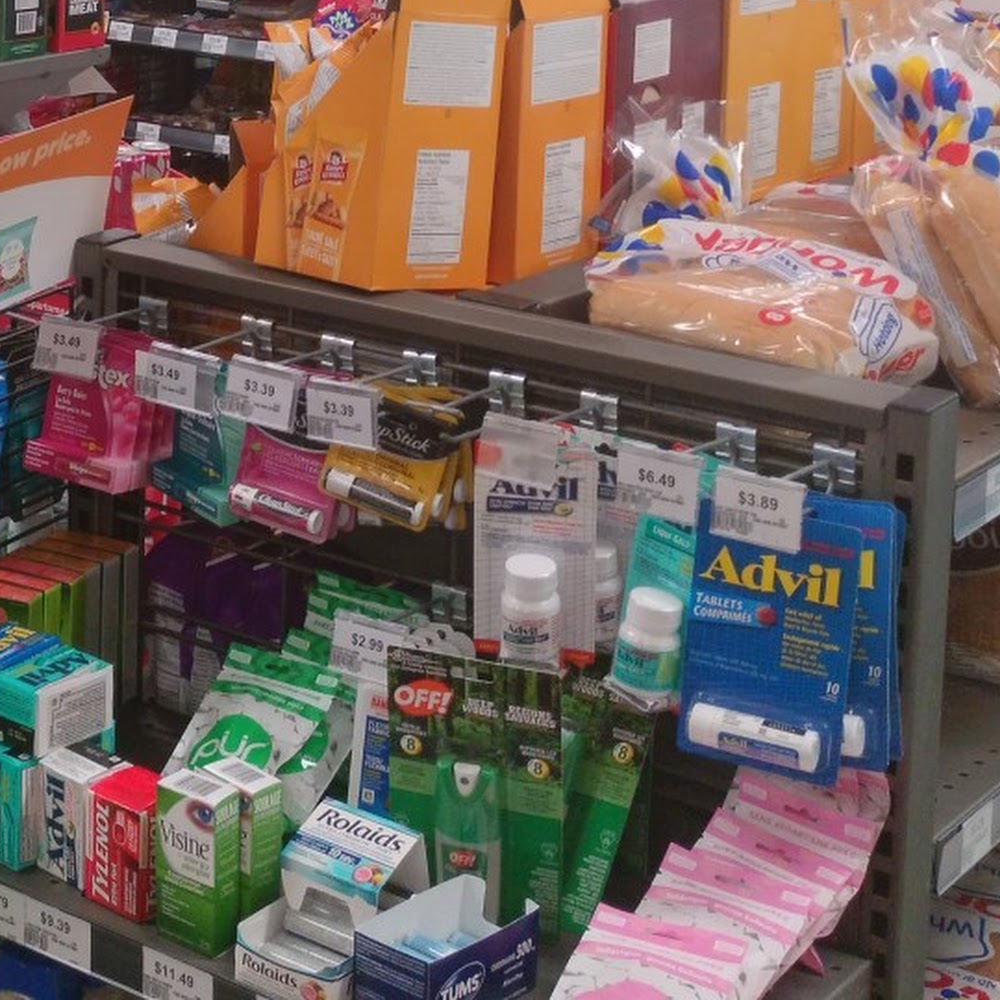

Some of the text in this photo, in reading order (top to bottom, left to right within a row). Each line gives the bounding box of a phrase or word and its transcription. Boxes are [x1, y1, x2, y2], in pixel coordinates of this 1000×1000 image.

[68, 2, 99, 16] MEAT
[33, 128, 92, 165] price.
[151, 364, 180, 380] $3.49
[244, 379, 275, 397] $3.39
[638, 468, 676, 488] $6.49
[737, 490, 779, 511] $3.89
[698, 545, 842, 609] Advil
[696, 591, 742, 611] TABLETS
[351, 632, 384, 653] $2.99
[20, 653, 91, 686] Advil
[868, 666, 882, 678] 10
[394, 684, 450, 713] OFF!
[826, 682, 840, 695] 10
[46, 773, 66, 878] Advil
[316, 808, 403, 852] Rolaids
[92, 802, 111, 903] TYLENOL
[161, 820, 210, 860] Visine
[450, 852, 476, 868] OFF!
[153, 960, 195, 989] $11.49
[240, 952, 298, 989] Rolaids
[438, 972, 481, 1000] TUMS
